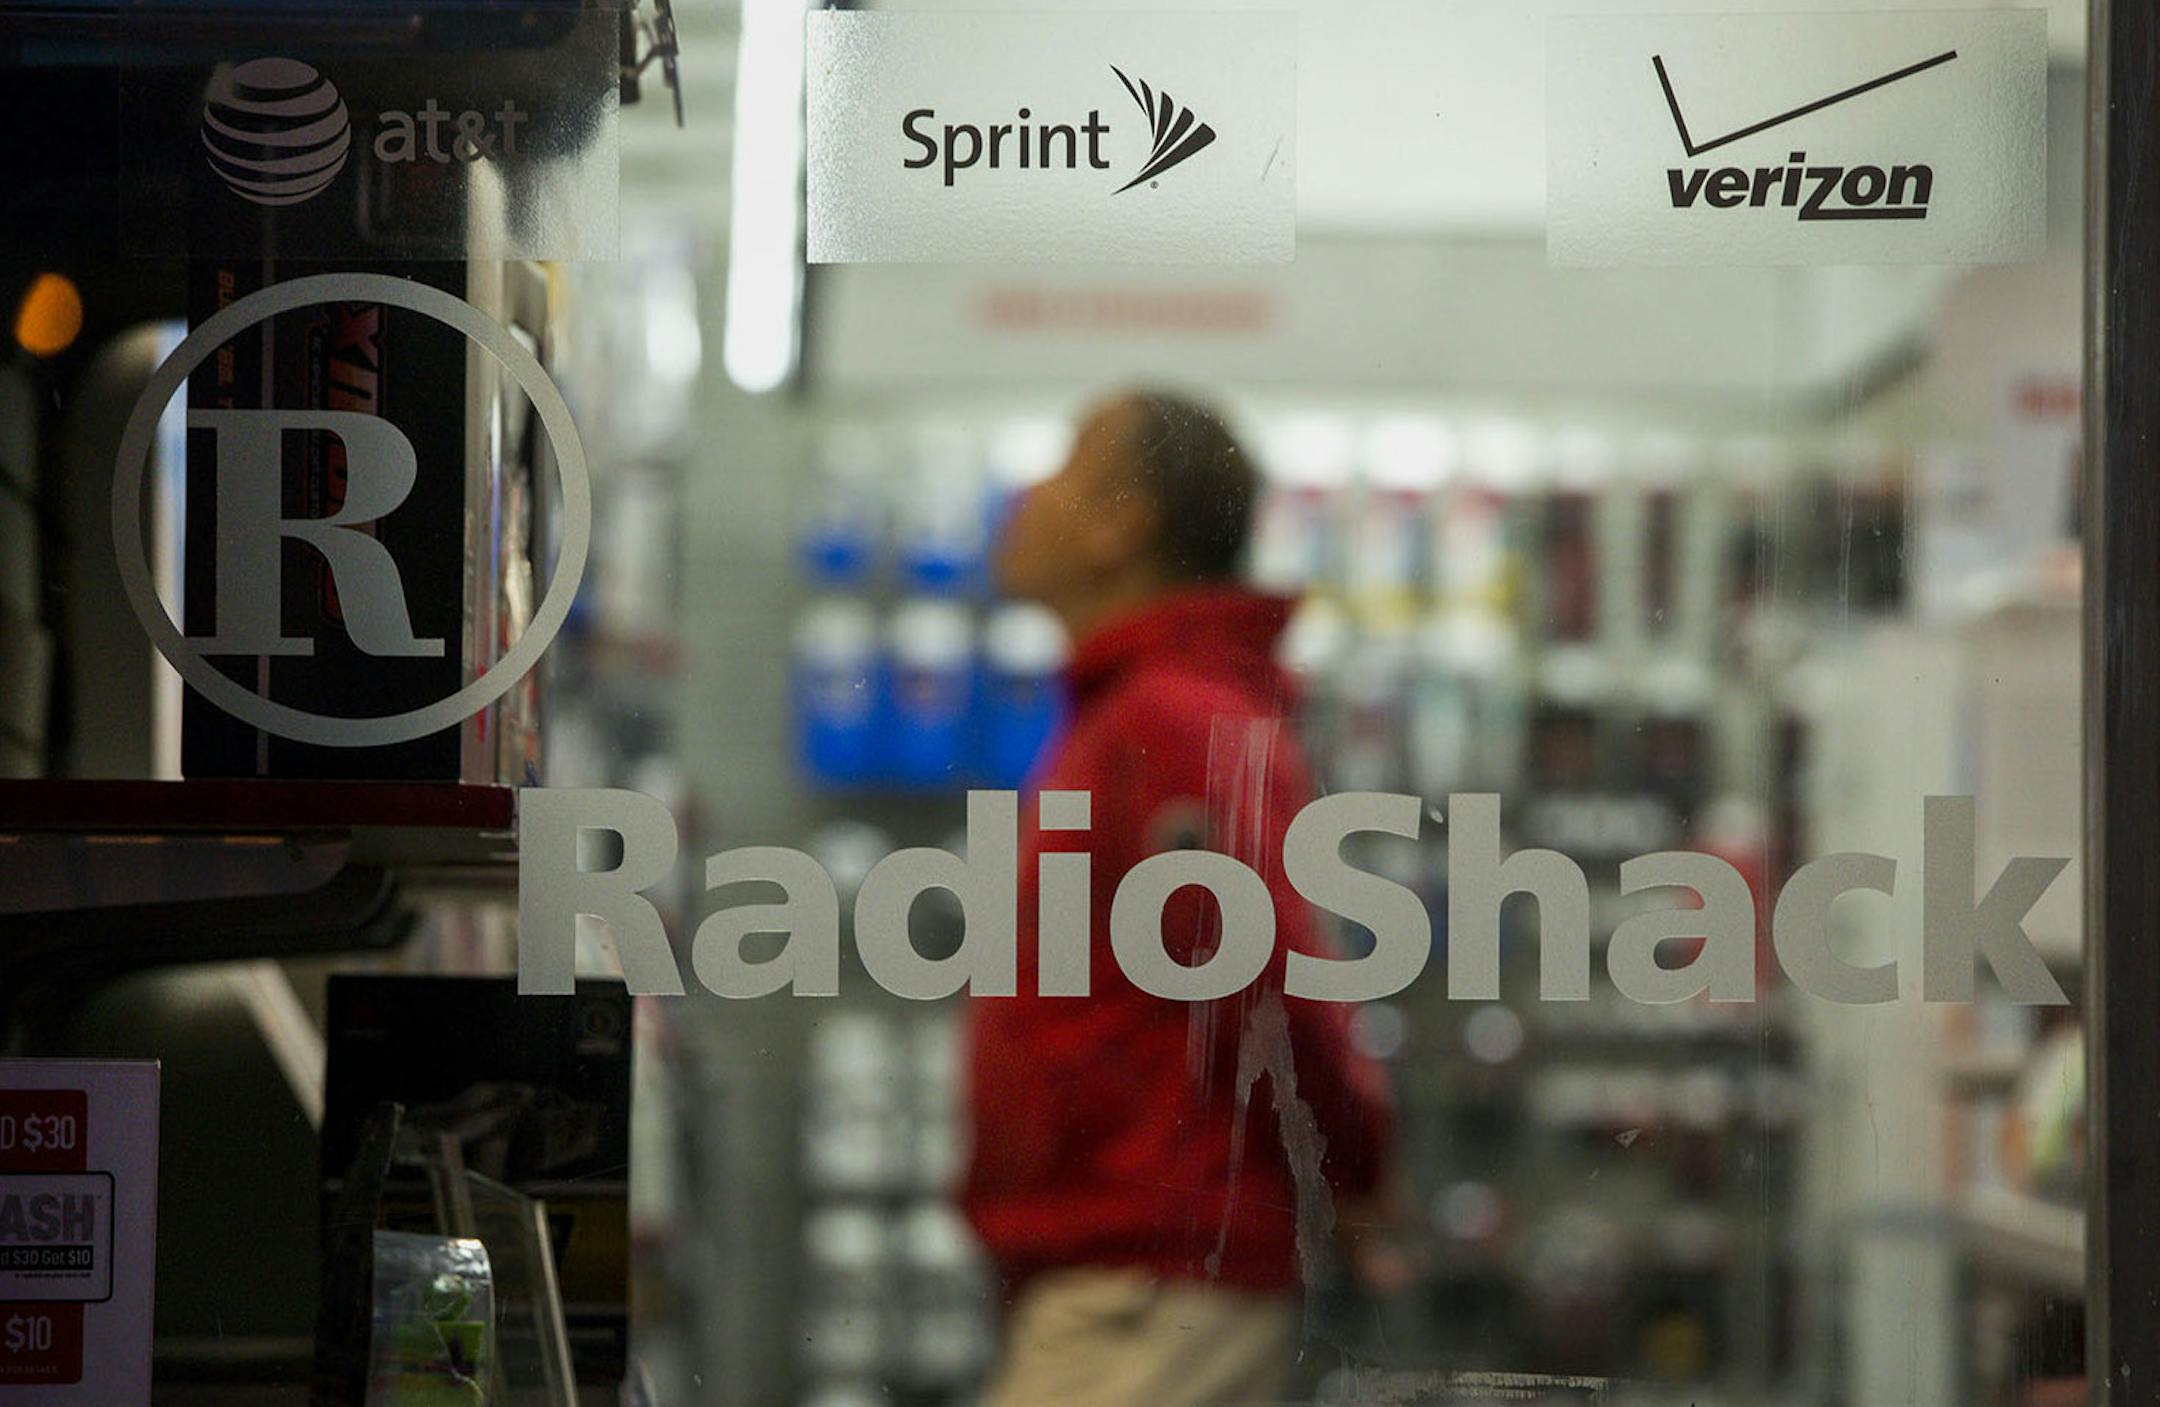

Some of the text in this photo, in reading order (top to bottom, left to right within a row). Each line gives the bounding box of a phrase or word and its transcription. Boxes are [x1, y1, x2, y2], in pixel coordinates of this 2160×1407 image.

[373, 98, 529, 164] at&t
[902, 107, 1111, 187] Sprint
[1667, 151, 1934, 221] verizon
[516, 786, 2073, 1006] RadioShack
[22, 1111, 76, 1152] $30
[12, 1248, 39, 1265] $30
[67, 1248, 92, 1266] $10
[4, 1312, 53, 1354] $10
